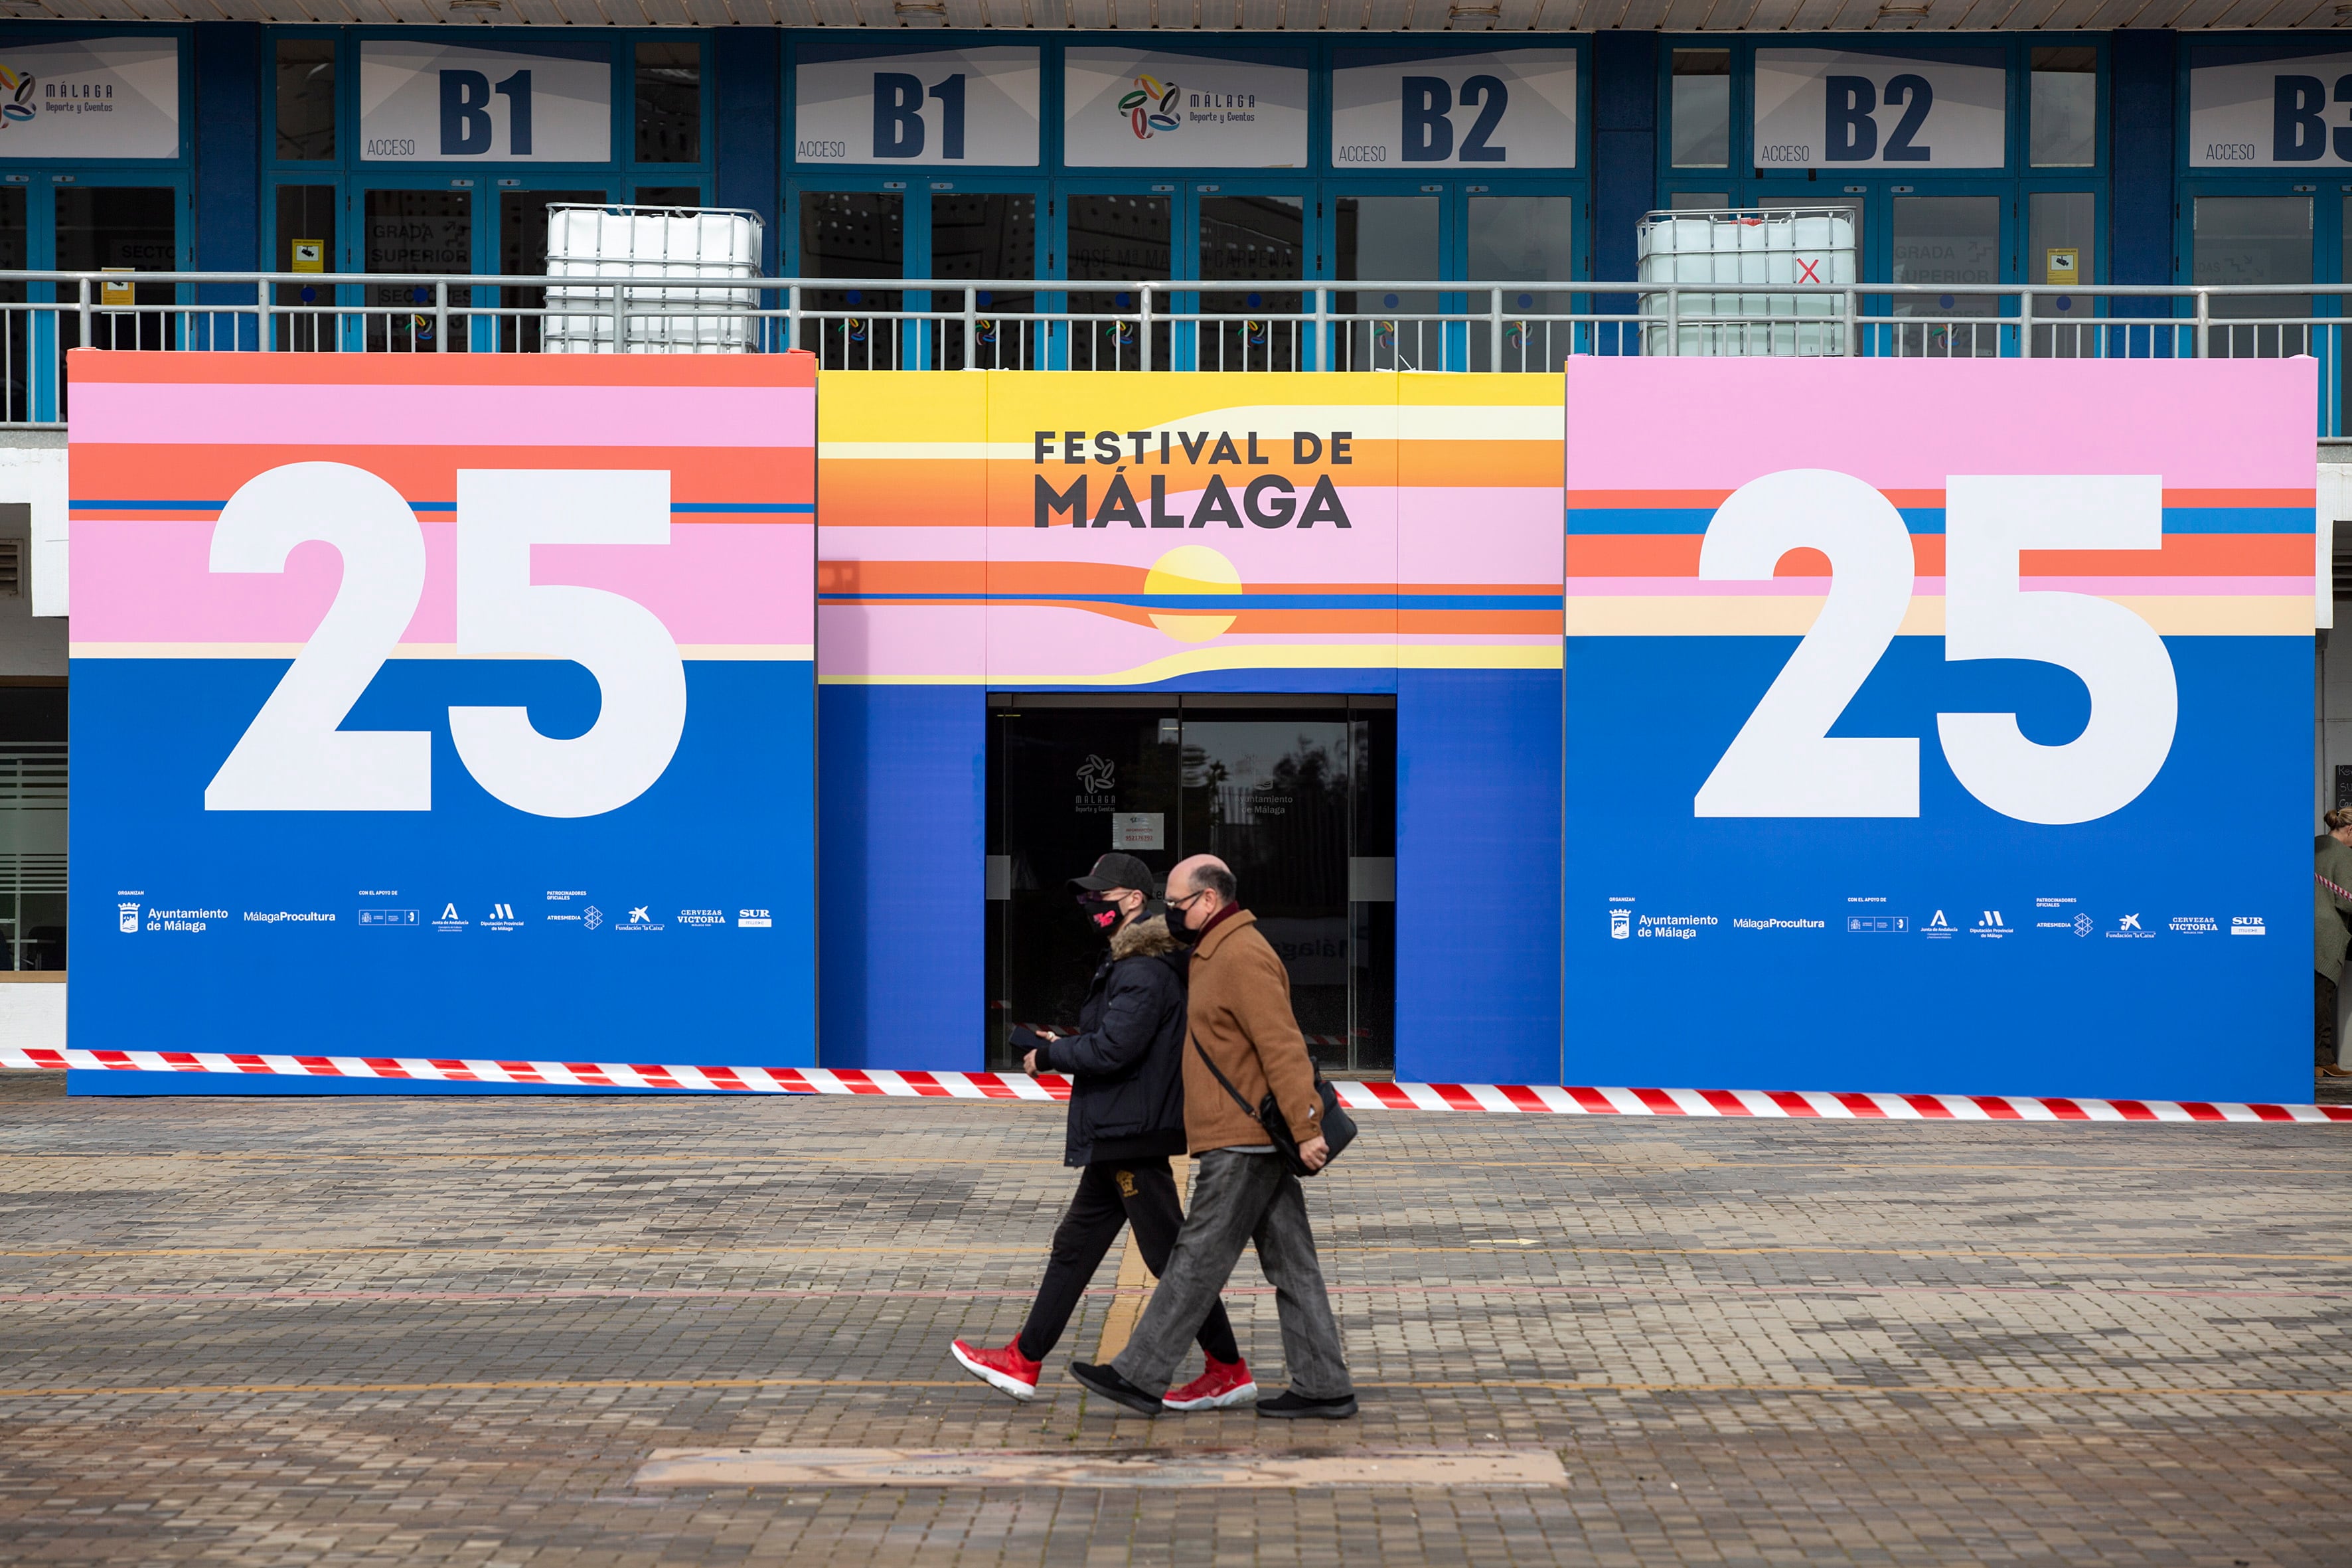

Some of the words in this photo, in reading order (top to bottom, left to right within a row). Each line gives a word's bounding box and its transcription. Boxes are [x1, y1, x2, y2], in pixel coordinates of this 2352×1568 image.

[46, 81, 113, 98] MÁLAGA
[1190, 91, 1255, 108] MÁLAGA
[46, 102, 74, 113] Deporte
[76, 104, 82, 114] y
[84, 102, 113, 112] Eventos
[439, 69, 532, 155] B1
[873, 72, 966, 159] B1
[1190, 112, 1217, 123] Deporte
[1220, 114, 1224, 123] y
[1227, 112, 1255, 121] Eventos
[1401, 75, 1509, 161] B2
[1825, 74, 1933, 161] B2
[367, 139, 415, 155] ACCESO
[797, 141, 846, 157] ACCESO
[1338, 145, 1387, 162] ACCESO
[1762, 145, 1810, 161] ACCESO
[2206, 143, 2255, 160] ACCESO
[372, 224, 434, 239] GRADA
[371, 249, 468, 263] SUPERIOR
[1895, 246, 1955, 260] GRADA
[1034, 431, 1269, 465] FESTIVAL
[1293, 431, 1352, 465] DE
[1034, 466, 1352, 529] MÁLAGA
[204, 461, 687, 819] 25
[1694, 468, 2178, 825] 25
[1075, 793, 1116, 804] MÁLAGA
[1235, 795, 1293, 805] Ayuntamiento
[1254, 805, 1285, 815] Málaga
[147, 907, 228, 921] Ayuntamiento
[244, 911, 336, 923] MálagaProcultura
[739, 909, 771, 917] SUR
[1638, 914, 1719, 927] Ayuntamiento
[2232, 916, 2264, 925] SUR
[147, 921, 161, 931] de
[165, 919, 206, 933] Málaga
[1733, 917, 1825, 930] MálagaProcultura
[1637, 927, 1652, 937] de
[1655, 927, 1697, 940] Málaga
